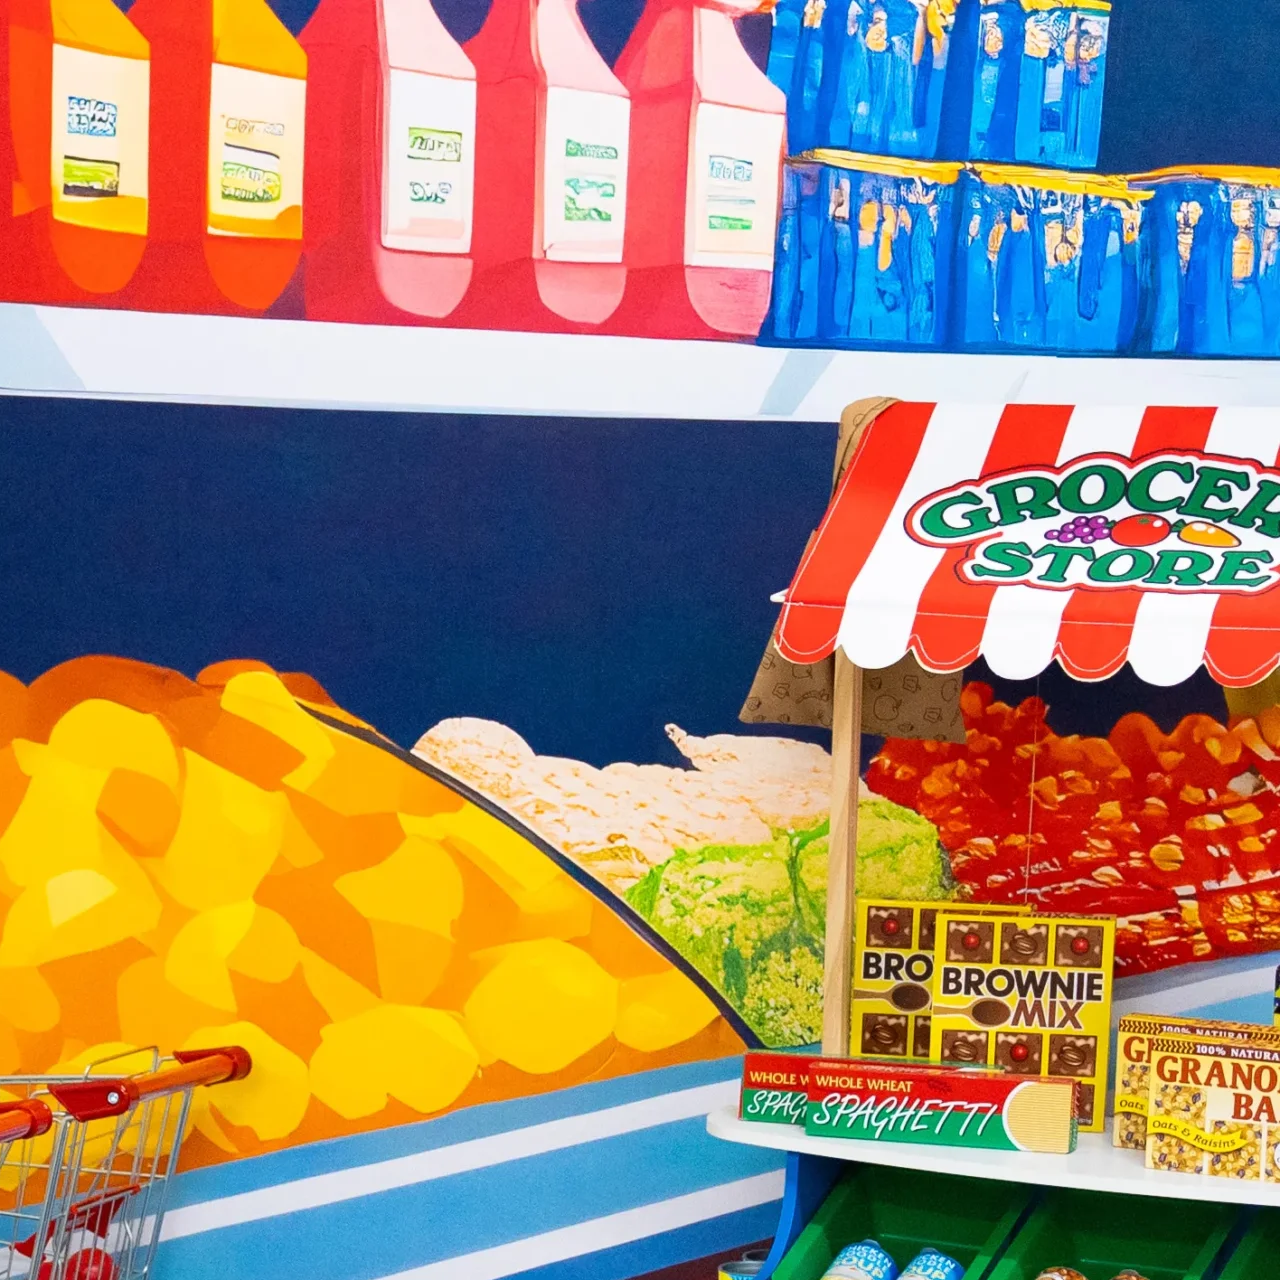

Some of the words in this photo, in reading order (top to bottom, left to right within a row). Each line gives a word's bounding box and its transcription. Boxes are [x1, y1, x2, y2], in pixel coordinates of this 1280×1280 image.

[971, 542, 1274, 587] STORE
[863, 951, 934, 982] BRO
[942, 967, 1104, 1001] BROWNIE
[1010, 999, 1085, 1030] MIX
[1195, 1044, 1226, 1056] 100%
[749, 1071, 795, 1086] WHOLE
[815, 1074, 864, 1090] WHOLE
[867, 1078, 913, 1093] WHEAT
[1156, 1055, 1280, 1093] GRANO
[747, 1090, 807, 1124] SPAG
[813, 1092, 998, 1139] SPAGHETTI
[1120, 1099, 1144, 1111] Oats
[1231, 1092, 1280, 1123] BA
[1152, 1119, 1179, 1131] Oats
[1181, 1126, 1191, 1137] &
[1193, 1134, 1237, 1148] Raisins
